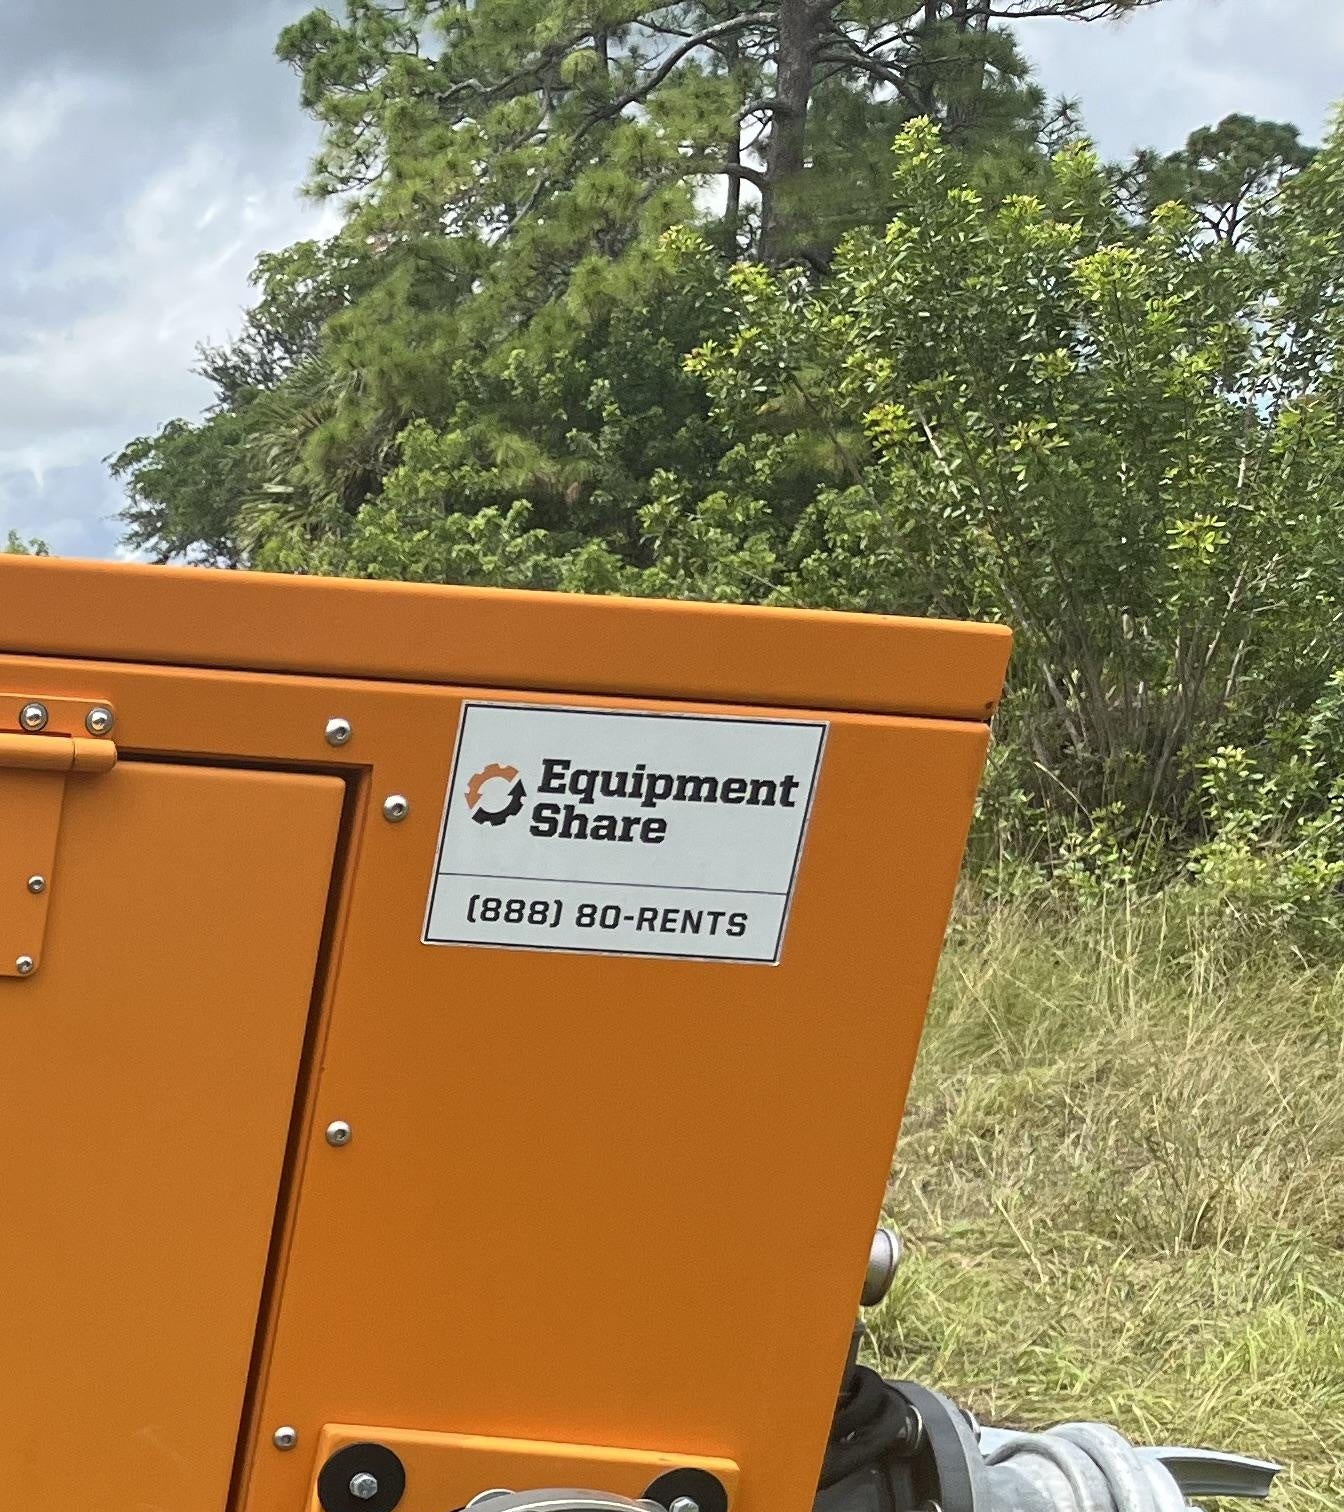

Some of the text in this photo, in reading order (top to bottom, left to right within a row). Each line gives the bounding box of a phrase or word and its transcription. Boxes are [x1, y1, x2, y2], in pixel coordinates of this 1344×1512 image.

[537, 757, 799, 808] Equipment
[529, 802, 667, 844] Share
[466, 894, 748, 938] (888) 80-RENTS
